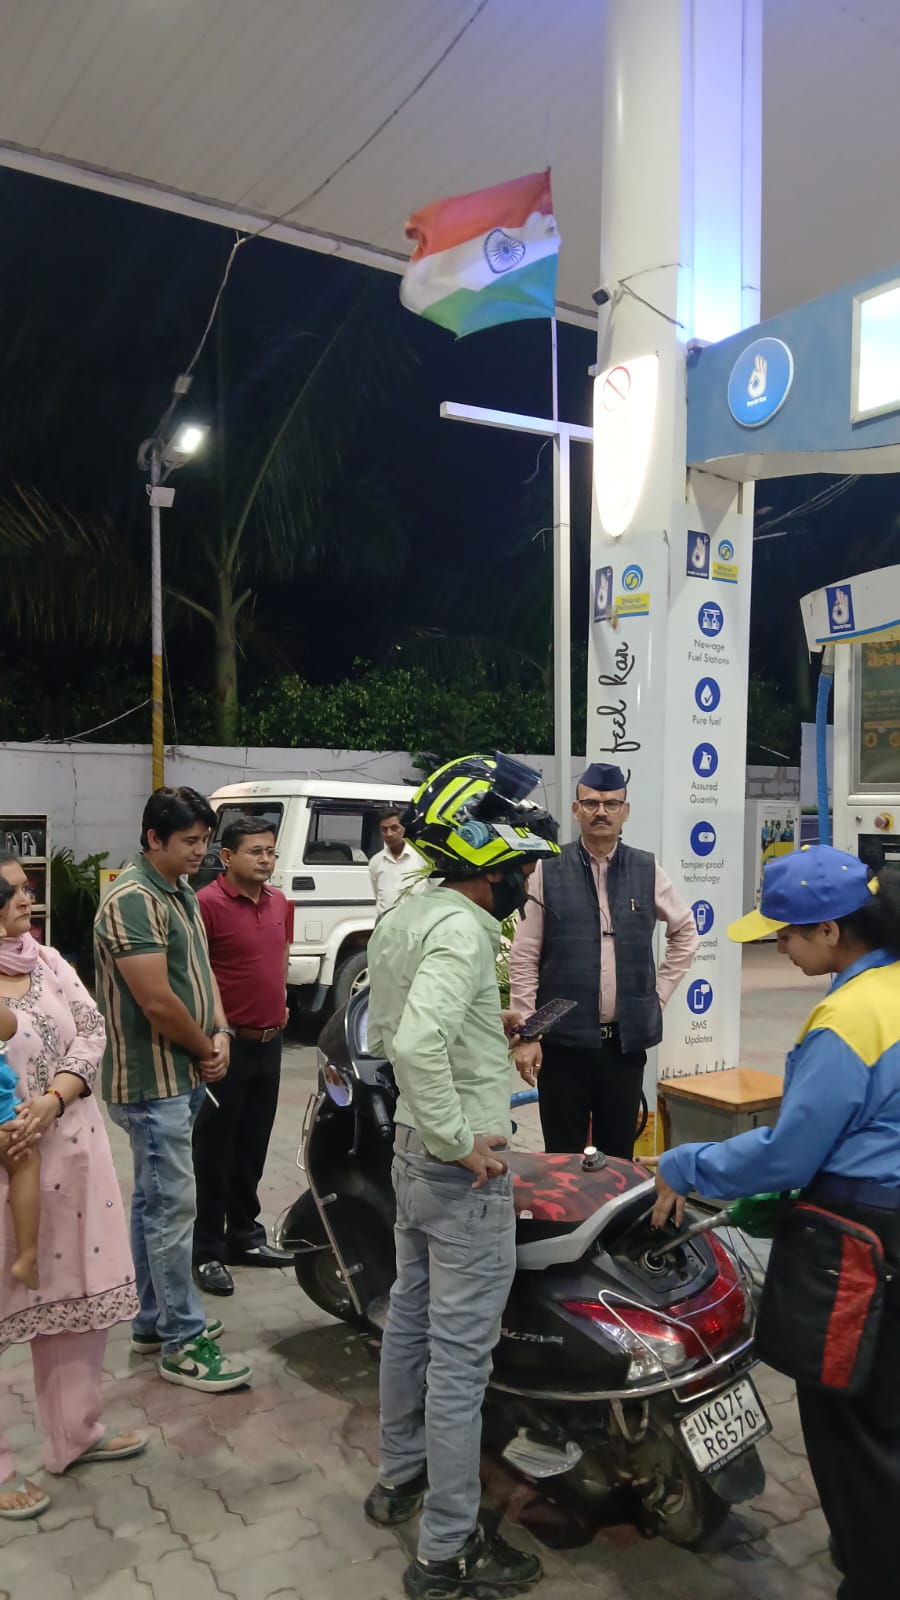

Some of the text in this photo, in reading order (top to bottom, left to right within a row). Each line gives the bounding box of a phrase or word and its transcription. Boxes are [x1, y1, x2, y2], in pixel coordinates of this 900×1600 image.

[687, 652, 730, 665] Fuel Stations
[692, 715, 721, 726] Pure fuel
[691, 782, 718, 791] Assured
[689, 794, 719, 807] Quantity
[680, 859, 724, 871] Tamper-proof
[683, 874, 720, 884] technology
[691, 1020, 708, 1030] SMS
[684, 1035, 713, 1046] Updates
[693, 1387, 743, 1435] UK07F
[703, 1409, 757, 1459] R6570
